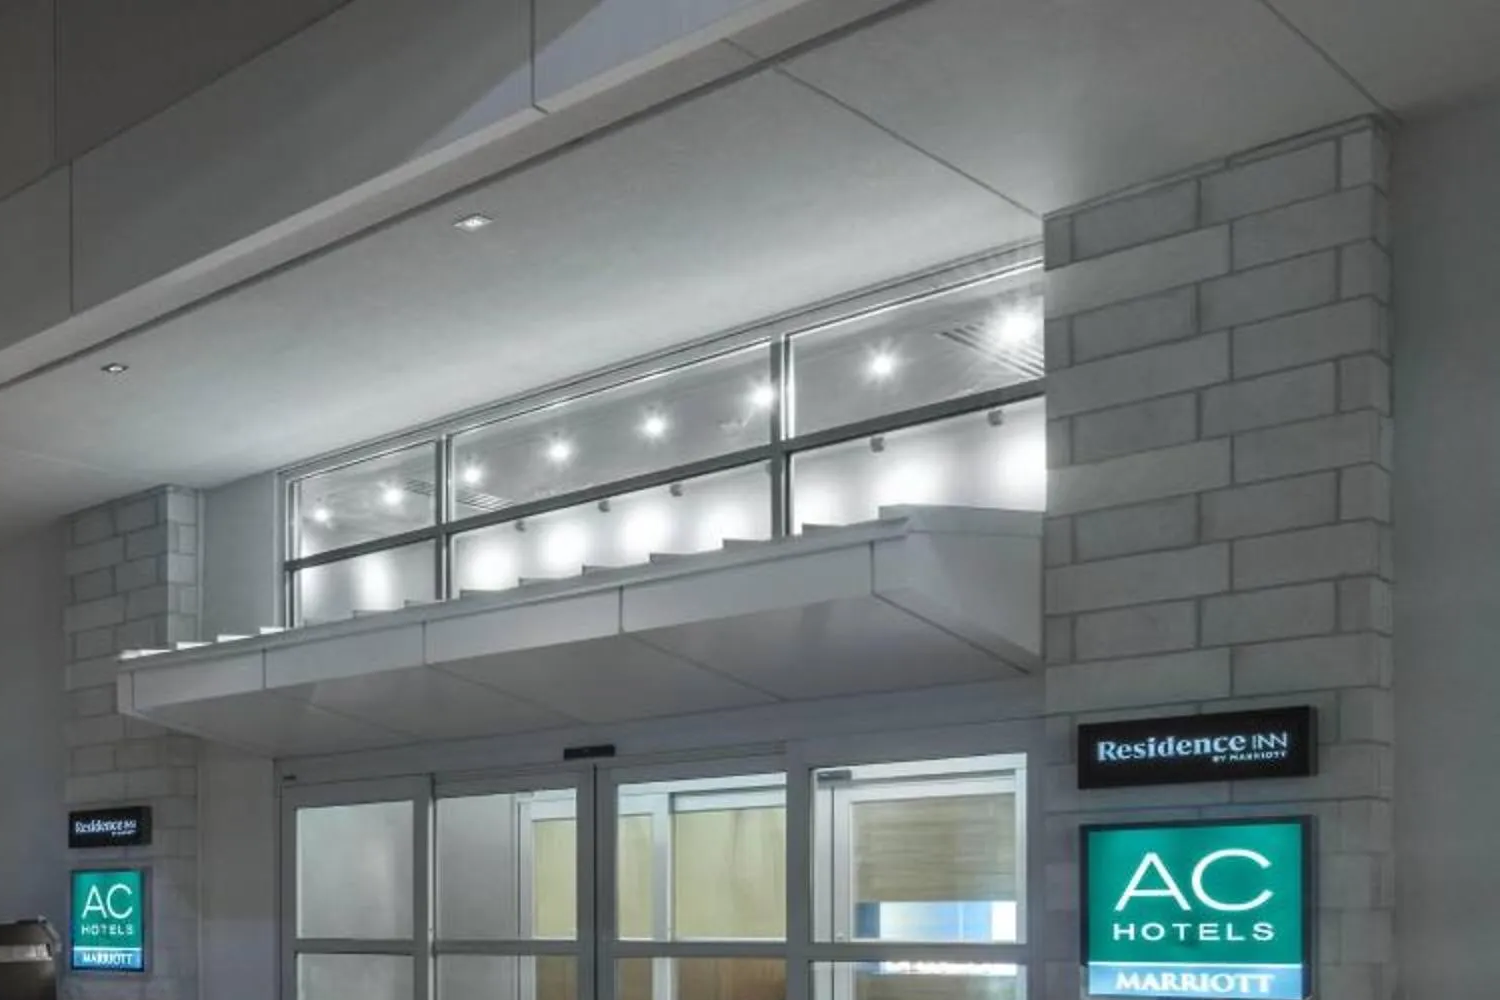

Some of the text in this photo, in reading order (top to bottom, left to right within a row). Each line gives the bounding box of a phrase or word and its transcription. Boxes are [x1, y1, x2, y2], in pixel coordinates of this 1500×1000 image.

[1097, 731, 1288, 761] Residence INN
[1229, 751, 1287, 762] MARRIOTT
[1113, 848, 1275, 912] AC
[81, 883, 134, 919] AC
[81, 924, 134, 936] HOTELS
[1112, 922, 1276, 942] HOTELS
[1114, 971, 1276, 994] MARRIOTT
